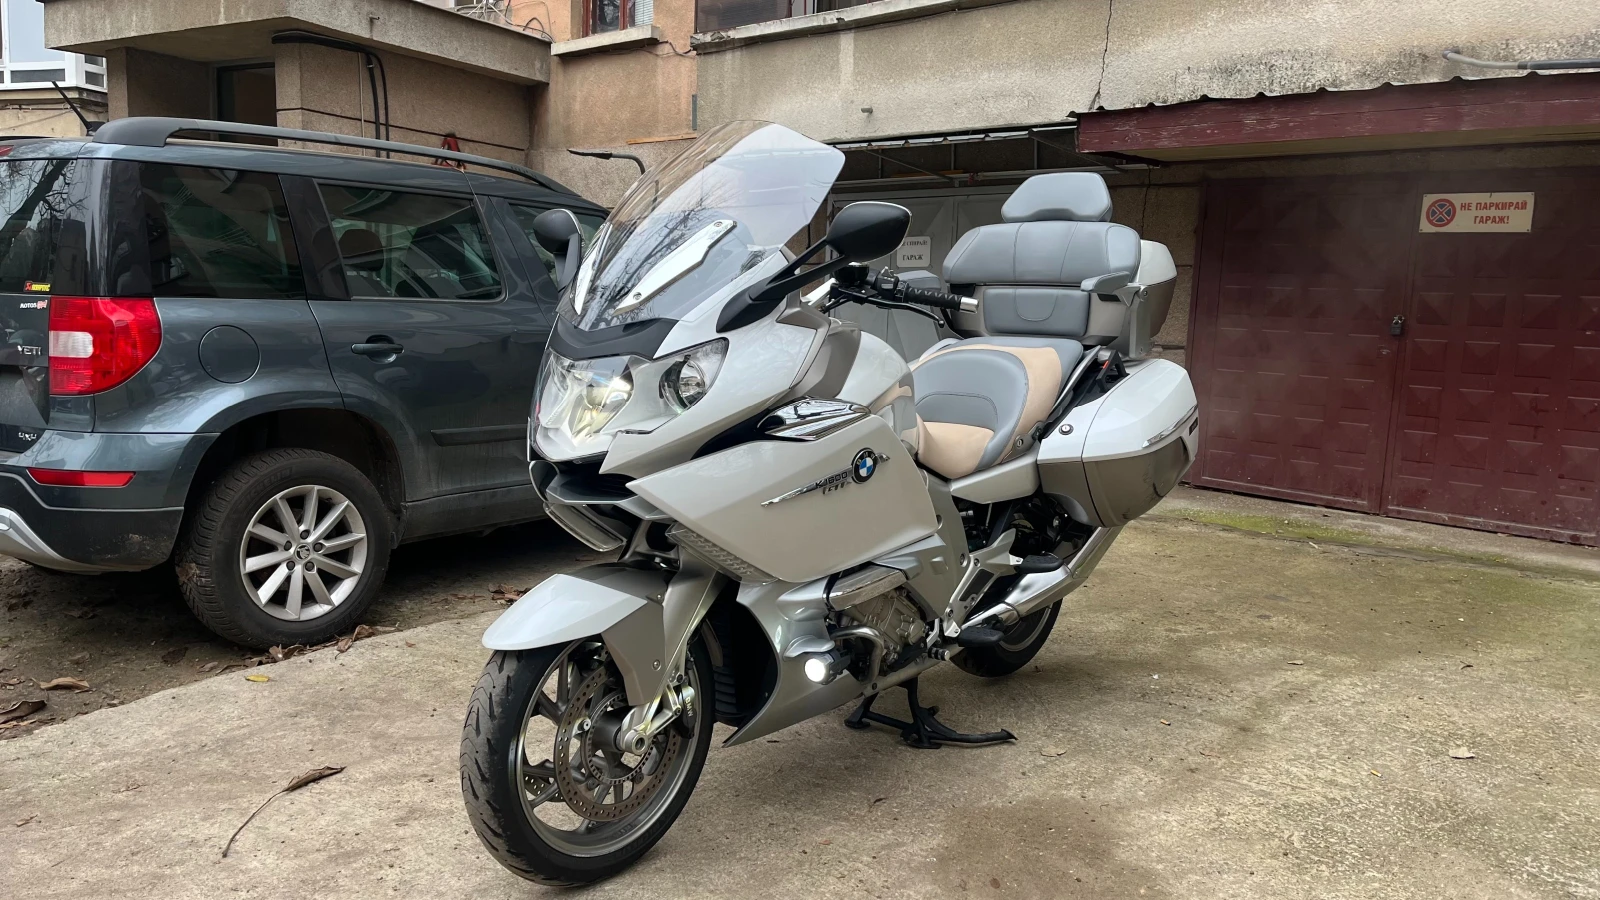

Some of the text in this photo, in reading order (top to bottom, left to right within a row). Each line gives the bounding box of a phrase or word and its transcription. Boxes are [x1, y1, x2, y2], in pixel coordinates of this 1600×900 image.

[1460, 200, 1528, 211] НЕ ПАРКИРАЙ
[1473, 215, 1510, 225] ГАРАЖ!
[17, 345, 42, 355] YETI
[685, 696, 694, 717] BMW
